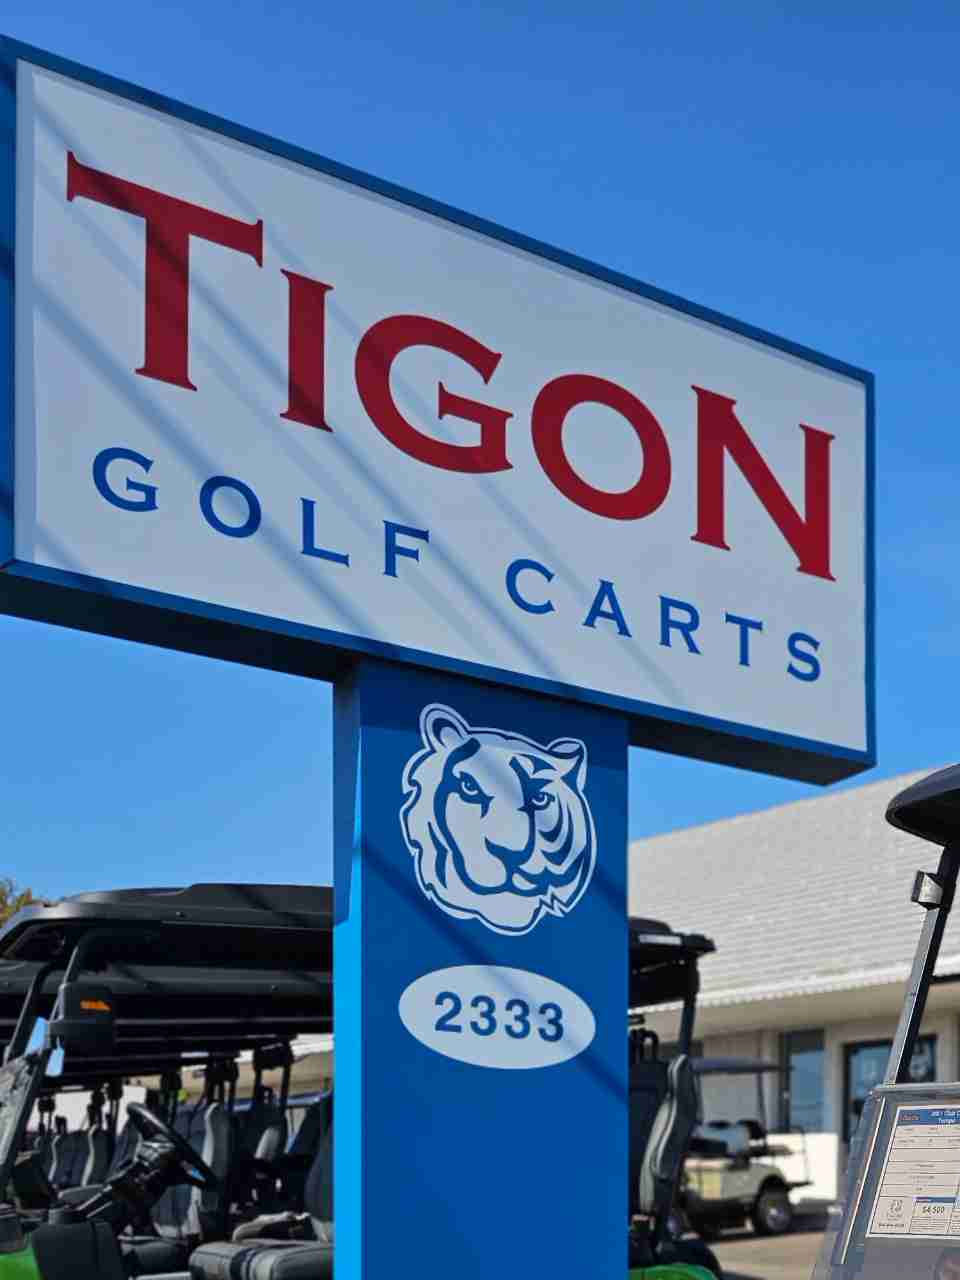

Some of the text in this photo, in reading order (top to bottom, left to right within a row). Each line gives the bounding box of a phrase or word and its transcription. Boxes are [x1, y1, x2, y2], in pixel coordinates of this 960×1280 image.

[67, 151, 836, 582] TIGON
[92, 446, 822, 683] GOLF CARTS
[434, 990, 565, 1043] 2333
